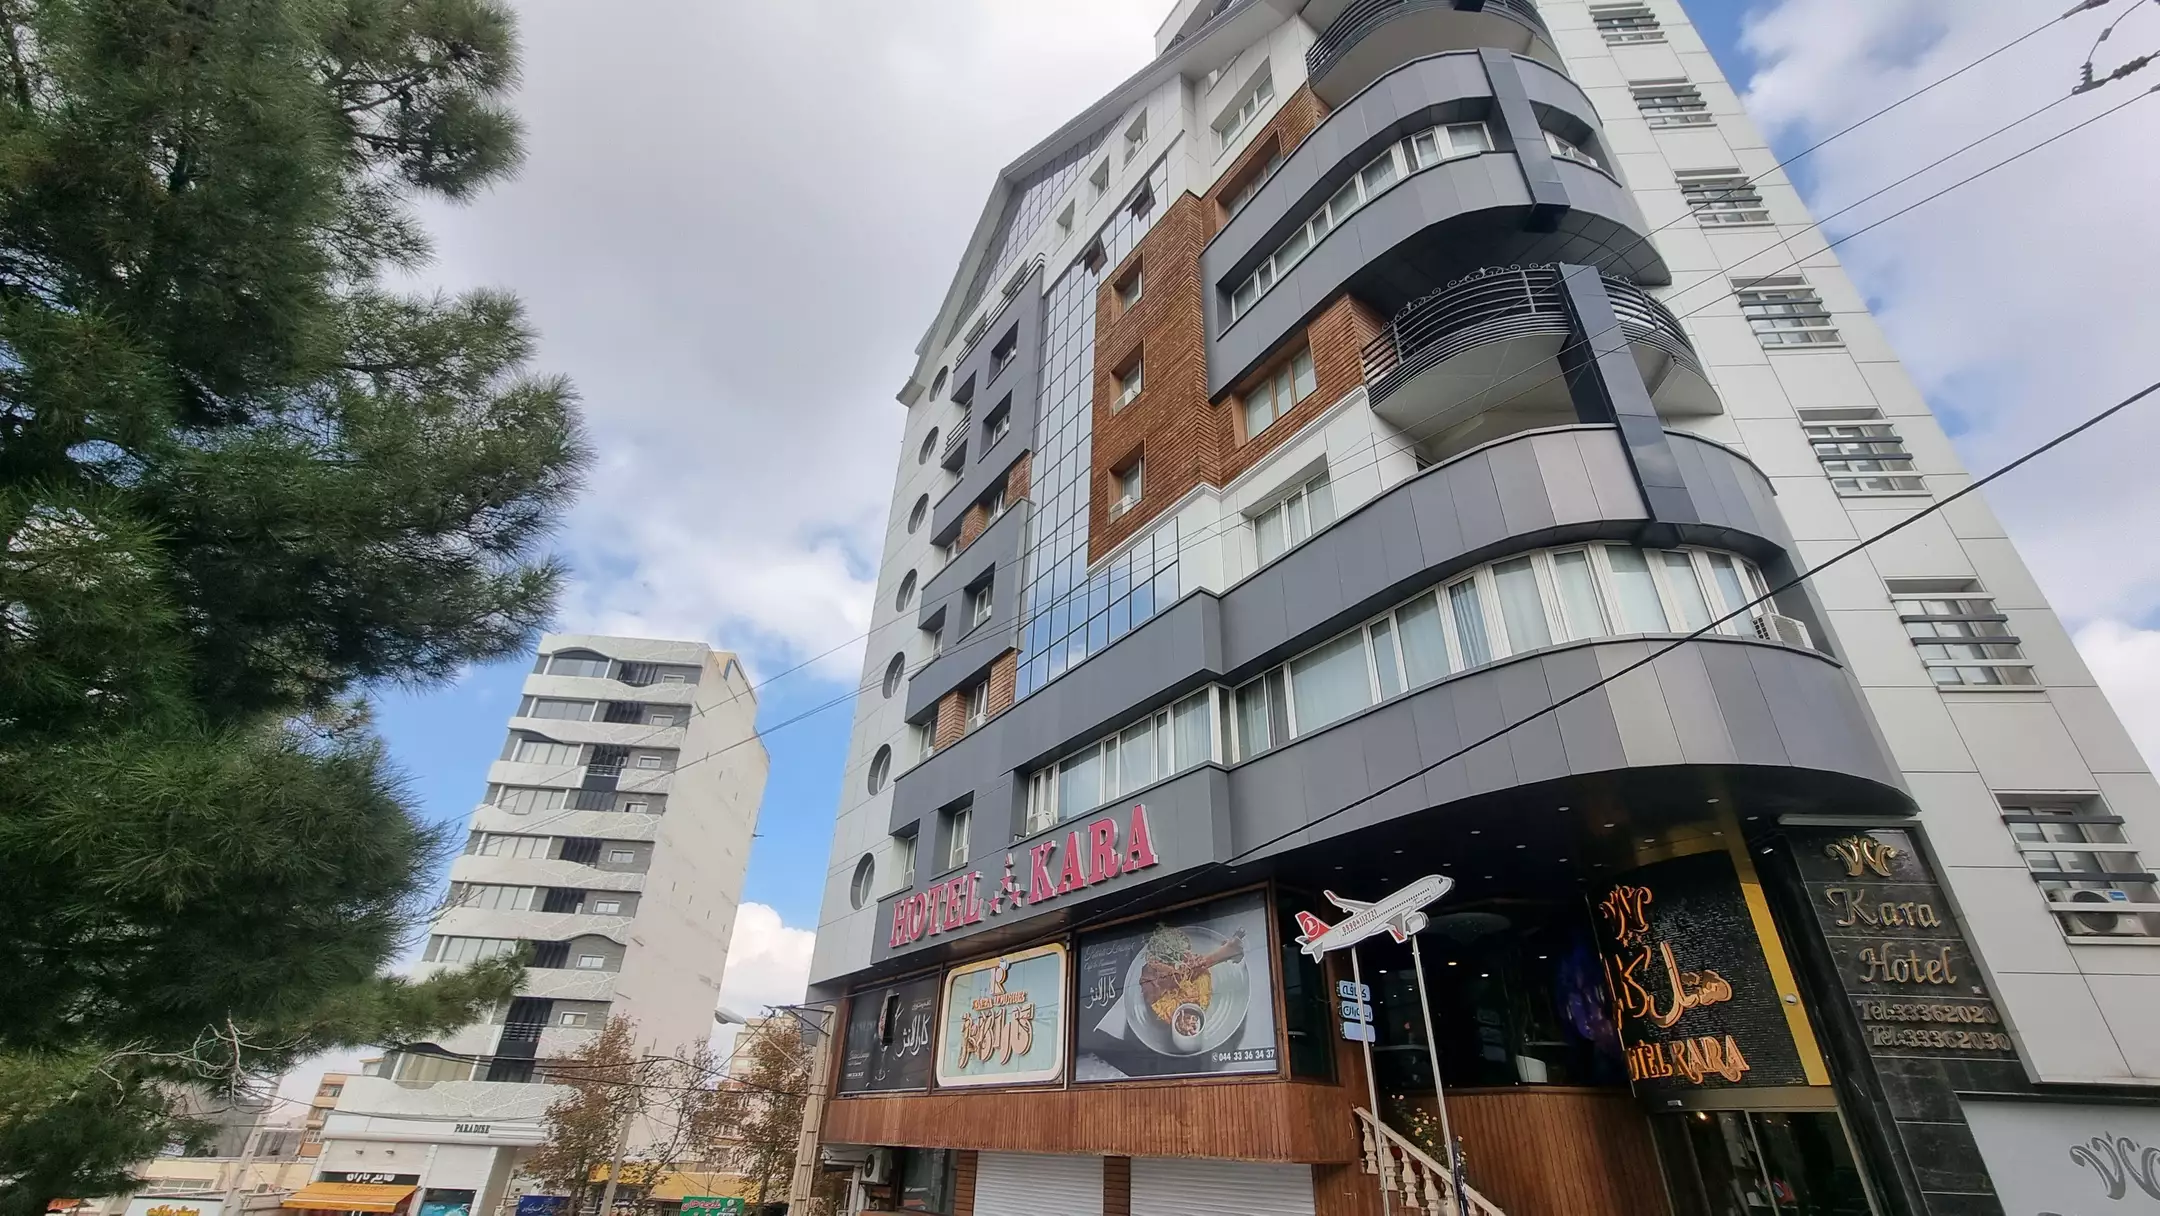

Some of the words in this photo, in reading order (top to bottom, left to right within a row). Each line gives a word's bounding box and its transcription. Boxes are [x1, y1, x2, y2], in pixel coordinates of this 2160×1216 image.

[889, 870, 985, 948] HOTEL
[1027, 803, 1159, 905] KARA
[1825, 887, 1942, 928] Kara
[1650, 940, 1733, 1028] هتل
[1859, 941, 1957, 984] Hotel
[1219, 1052, 1231, 1061] 044
[1233, 1051, 1242, 1060] 33
[1244, 1050, 1253, 1060] 36
[1255, 1050, 1264, 1059] 34
[1266, 1049, 1275, 1058] 37
[1670, 1034, 1750, 1084] KARA
[454, 1124, 491, 1133] PARADISE
